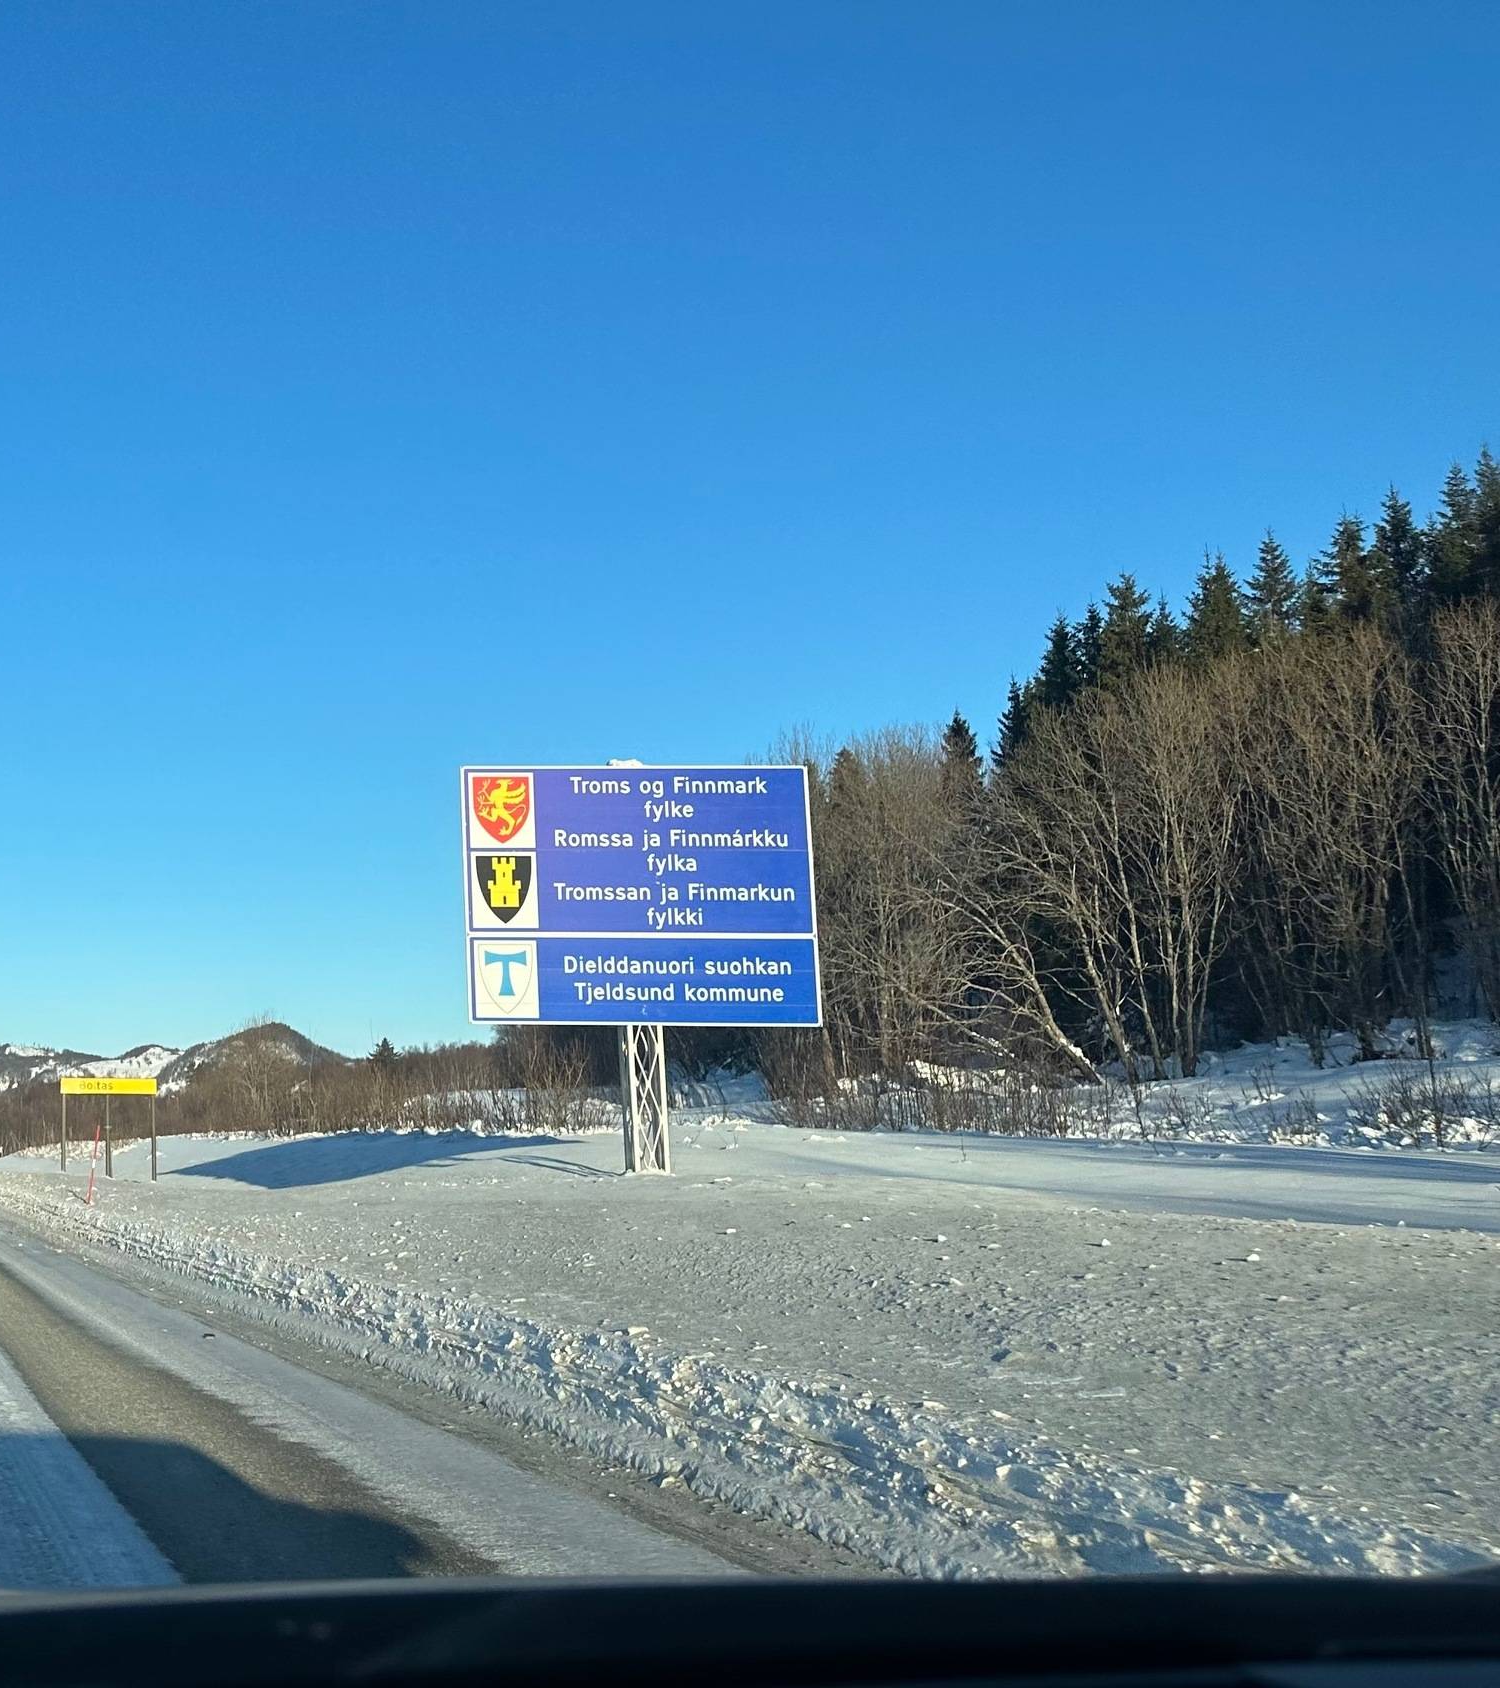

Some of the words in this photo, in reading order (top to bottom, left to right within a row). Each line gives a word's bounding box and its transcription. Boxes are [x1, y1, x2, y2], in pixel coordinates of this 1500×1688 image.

[569, 776, 631, 795] Troms
[639, 780, 664, 799] og
[673, 776, 768, 795] Finnmark
[643, 800, 694, 823] fylke
[554, 829, 634, 848] Romssa
[642, 829, 661, 852] ja
[669, 829, 789, 848] Finnmárkku
[646, 853, 698, 876] fylka
[553, 882, 651, 901] Tromssan
[659, 882, 679, 906] ja
[687, 882, 795, 902] Finmarkun
[646, 906, 703, 930] fylkki
[563, 955, 695, 975] Dielddanuori
[704, 956, 792, 976] suohkan
[573, 981, 675, 1005] Tjeldsund
[684, 982, 784, 1002] kommune
